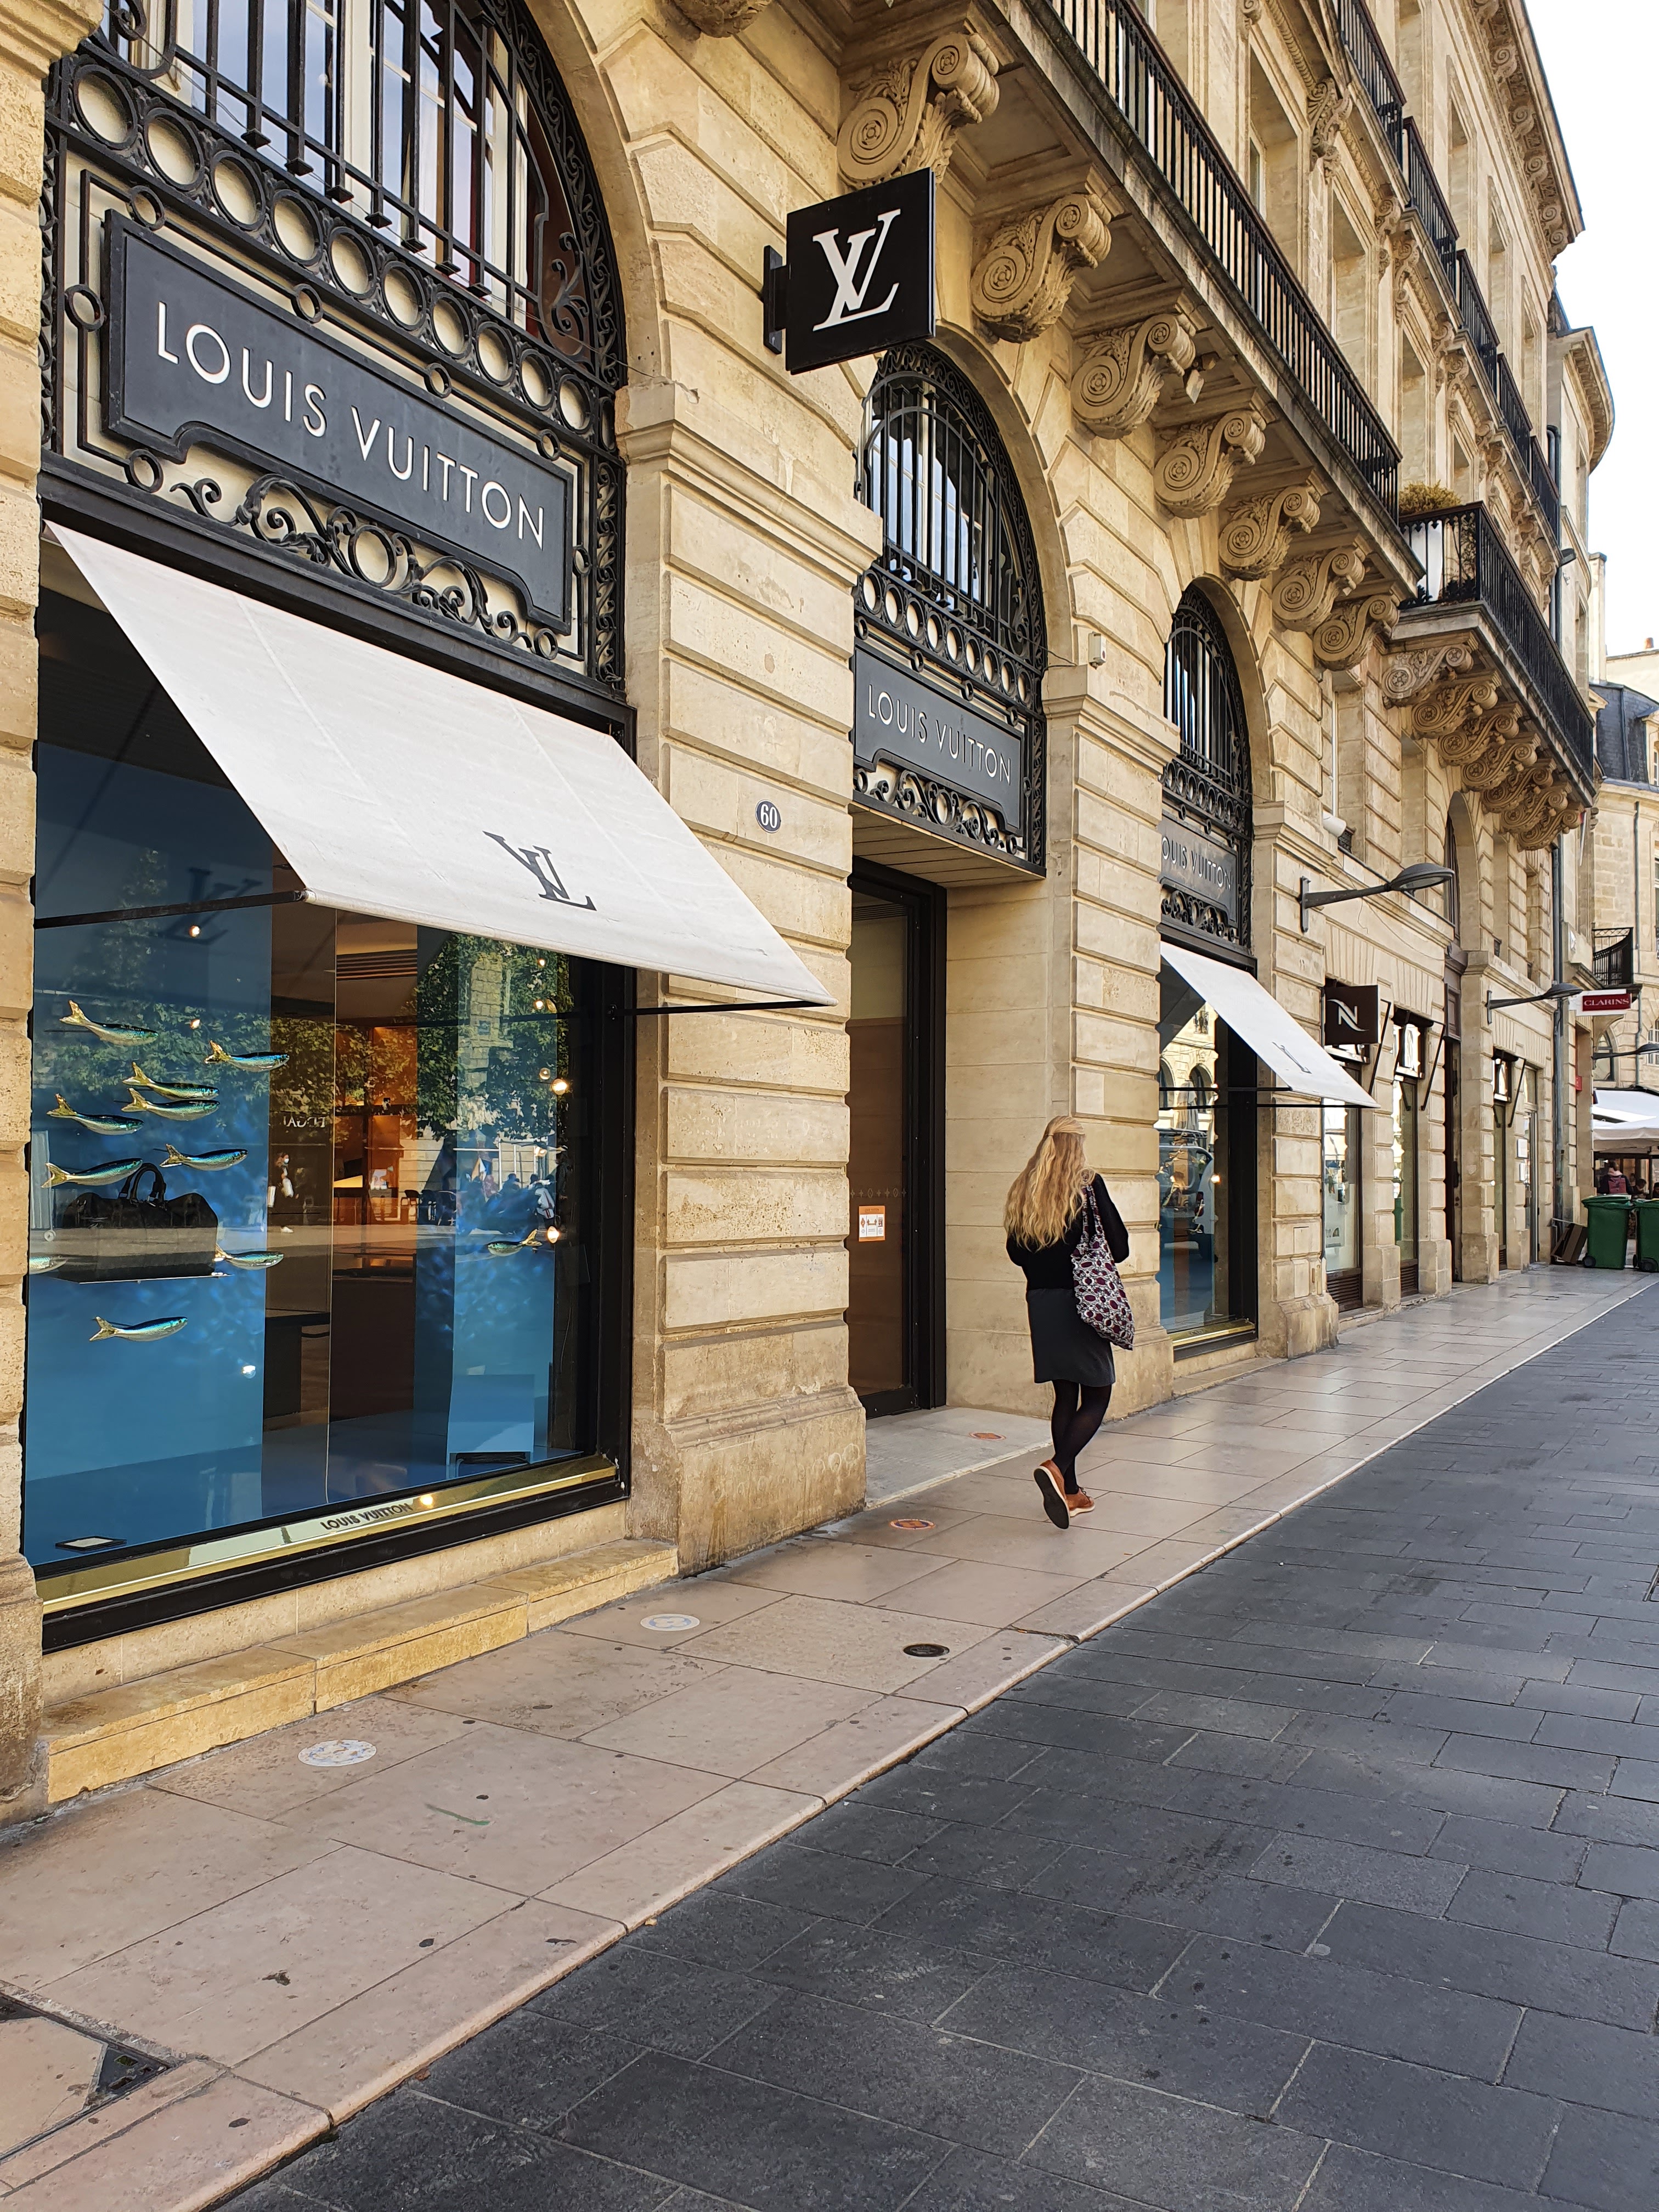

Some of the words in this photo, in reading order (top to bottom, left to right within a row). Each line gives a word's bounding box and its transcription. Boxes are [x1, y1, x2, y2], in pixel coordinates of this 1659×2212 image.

[157, 301, 327, 437] LOUIS
[351, 405, 544, 551] VUITTON
[868, 684, 928, 743] LOUIS
[935, 720, 1011, 786] VUITTON
[760, 804, 777, 828] 60
[1162, 837, 1187, 869] OUIS
[1191, 850, 1232, 891] VUITTON
[320, 1515, 360, 1530] LOUIS
[358, 1503, 413, 1521] VUITTON
